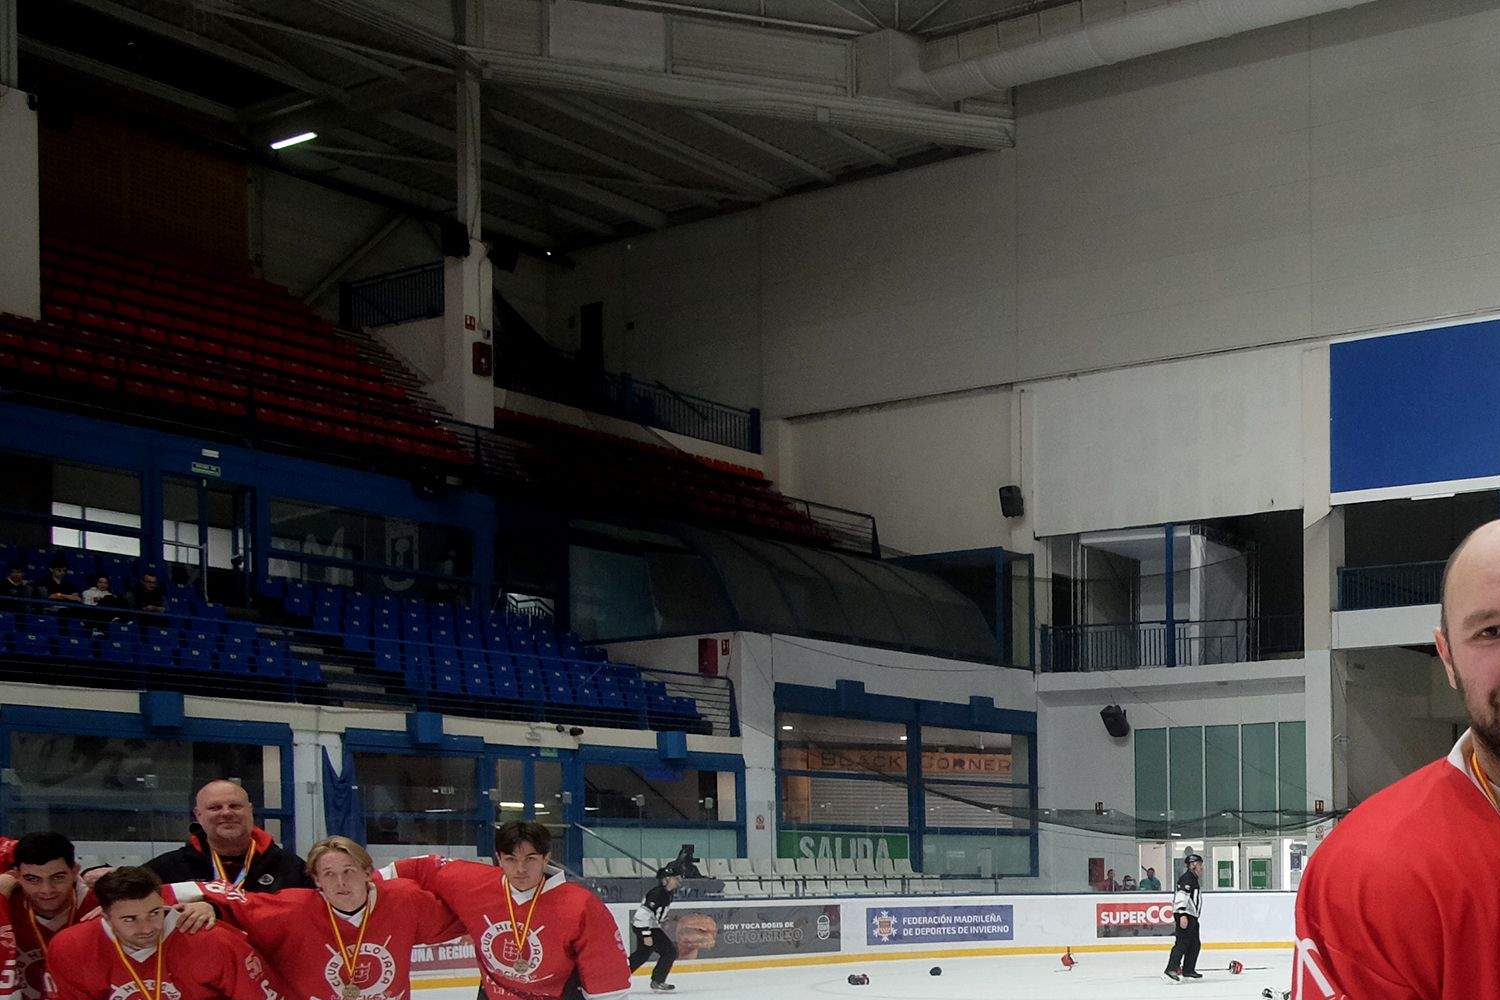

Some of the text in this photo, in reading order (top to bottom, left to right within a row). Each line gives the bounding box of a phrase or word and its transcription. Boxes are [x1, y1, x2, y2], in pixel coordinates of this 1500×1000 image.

[799, 836, 891, 860] SALIDA
[902, 912, 1002, 925] FEDERACIÓN MADRILEÑA
[740, 922, 760, 930] TOCA
[902, 924, 1009, 936] DE DEPORTES DE INVIERNO
